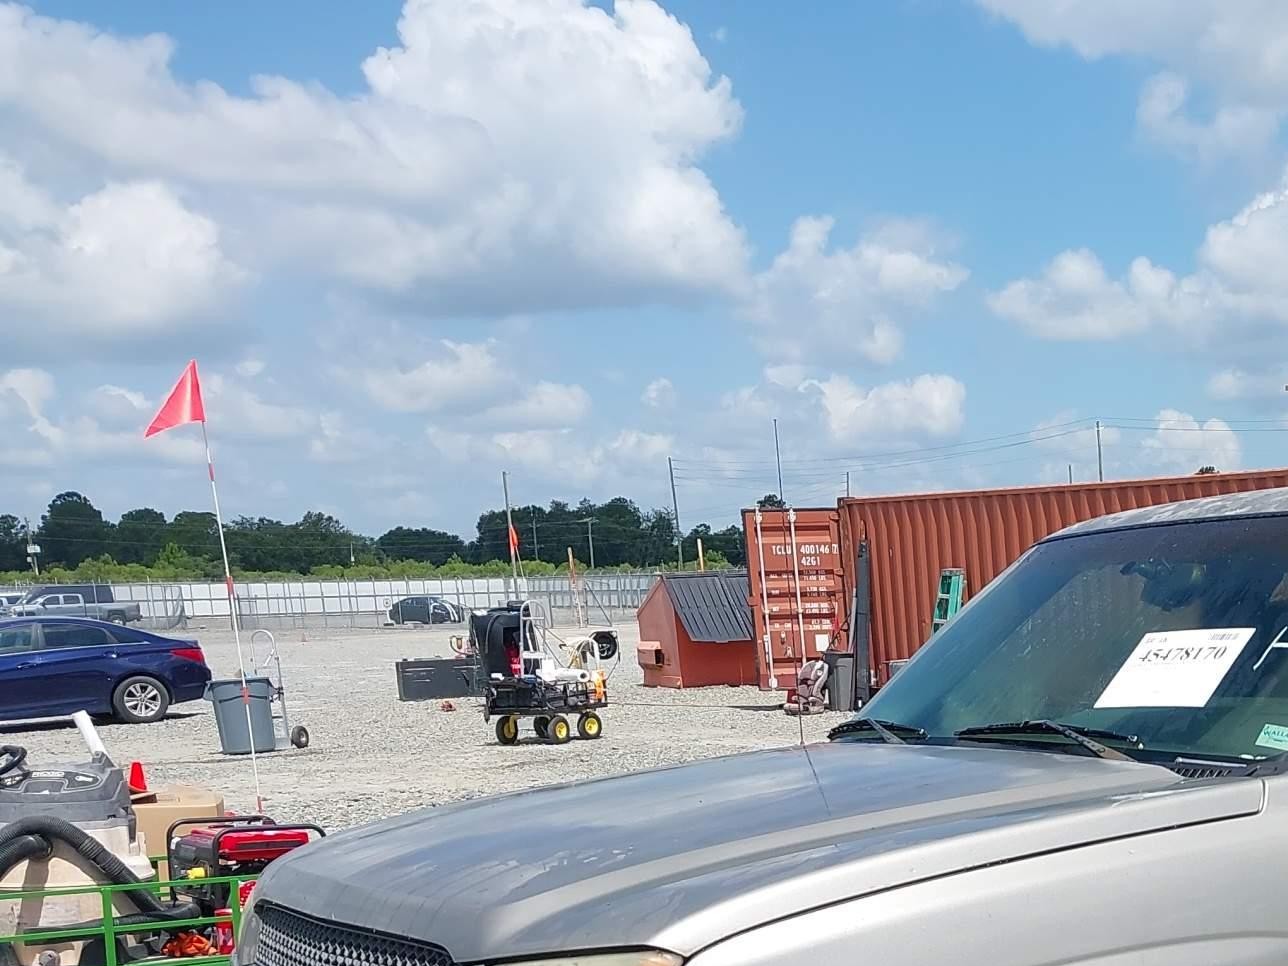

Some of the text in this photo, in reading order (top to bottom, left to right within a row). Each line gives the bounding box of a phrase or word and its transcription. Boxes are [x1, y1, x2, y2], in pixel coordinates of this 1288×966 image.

[771, 545, 792, 555] TCLU
[800, 544, 830, 555] 400146
[801, 556, 820, 566] 42G1
[1139, 646, 1228, 662] 45478170
